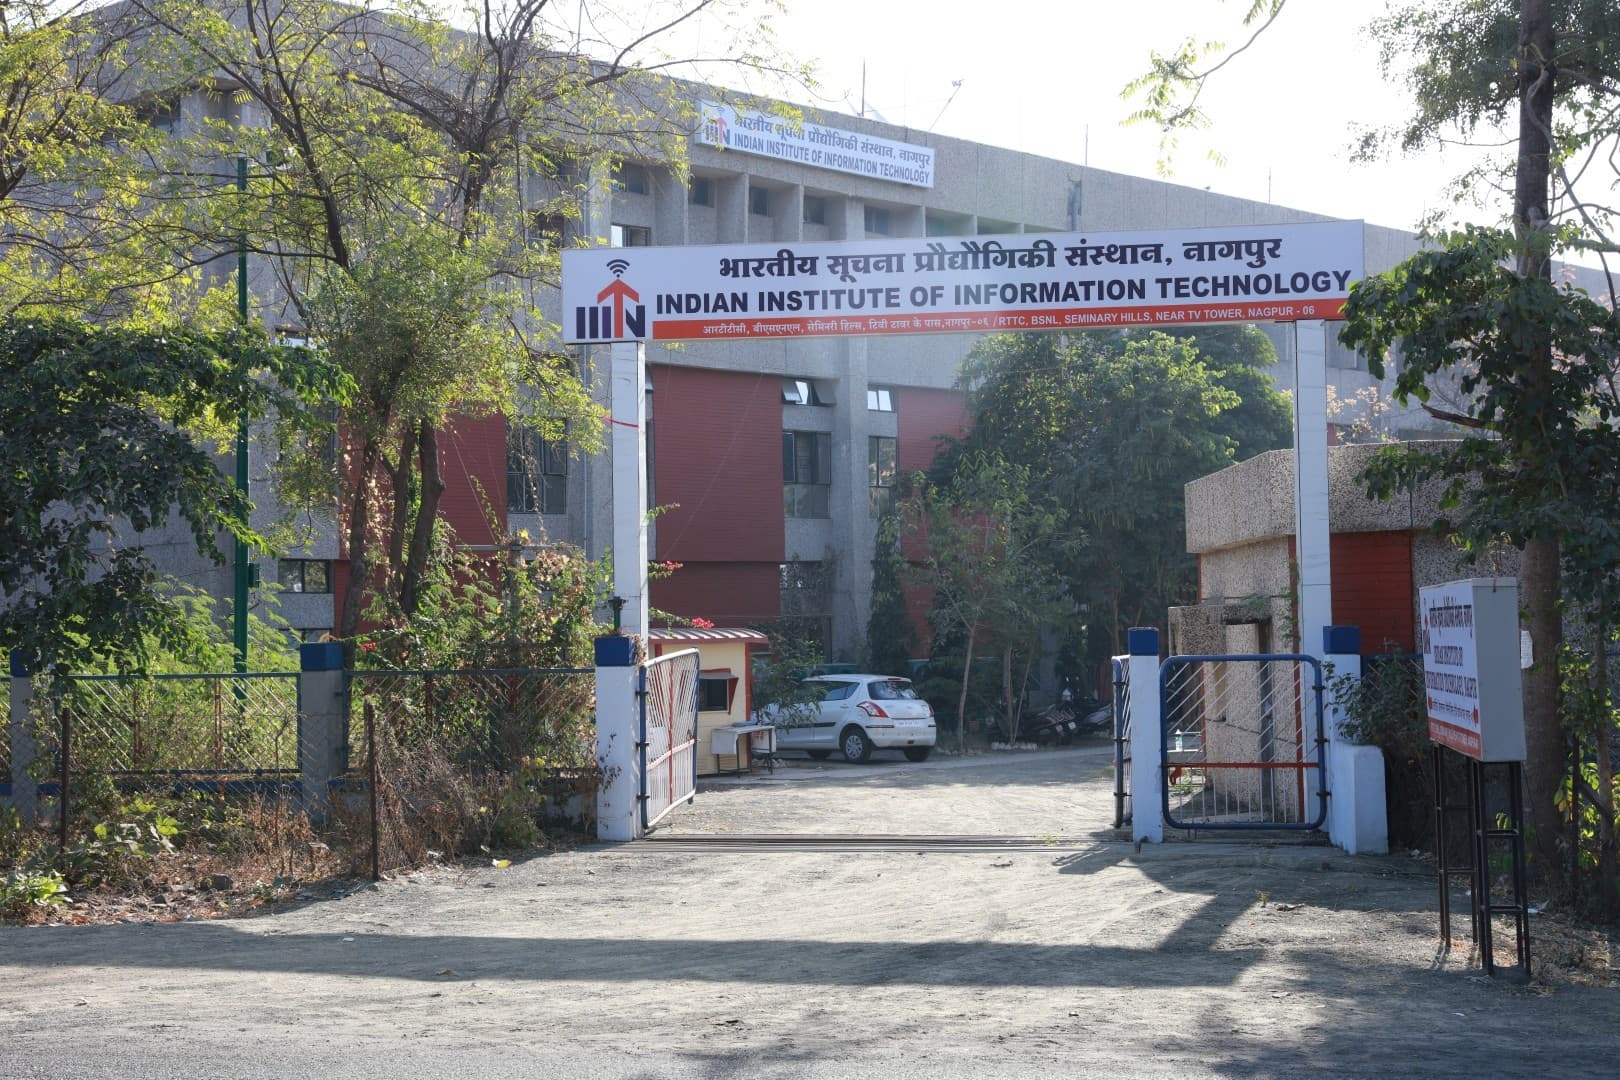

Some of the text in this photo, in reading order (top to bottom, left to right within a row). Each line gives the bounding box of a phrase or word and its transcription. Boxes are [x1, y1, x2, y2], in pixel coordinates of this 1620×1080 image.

[734, 132, 930, 184] INDIAN INSTITUTE OF INFORMATION TECHNOLOGY
[898, 149, 931, 169] नागपुर
[719, 248, 819, 278] भारतीय
[826, 252, 906, 283] सूचना
[1065, 237, 1173, 267] संस्थान,
[1182, 237, 1282, 269] नागपुर
[656, 269, 1352, 315] INDIAN INSTITUTE OF INFORMATION TECHNOLOGY
[913, 316, 922, 328] के
[1031, 314, 1062, 326] BSNL,
[1065, 312, 1118, 324] SEMINARY
[1120, 311, 1154, 323] HILLS,
[1155, 310, 1185, 321] NEAR
[1188, 309, 1201, 319] TV
[1204, 308, 1245, 319] TOWER,
[1248, 306, 1294, 317] NAGPUR
[1302, 305, 1315, 316] 06
